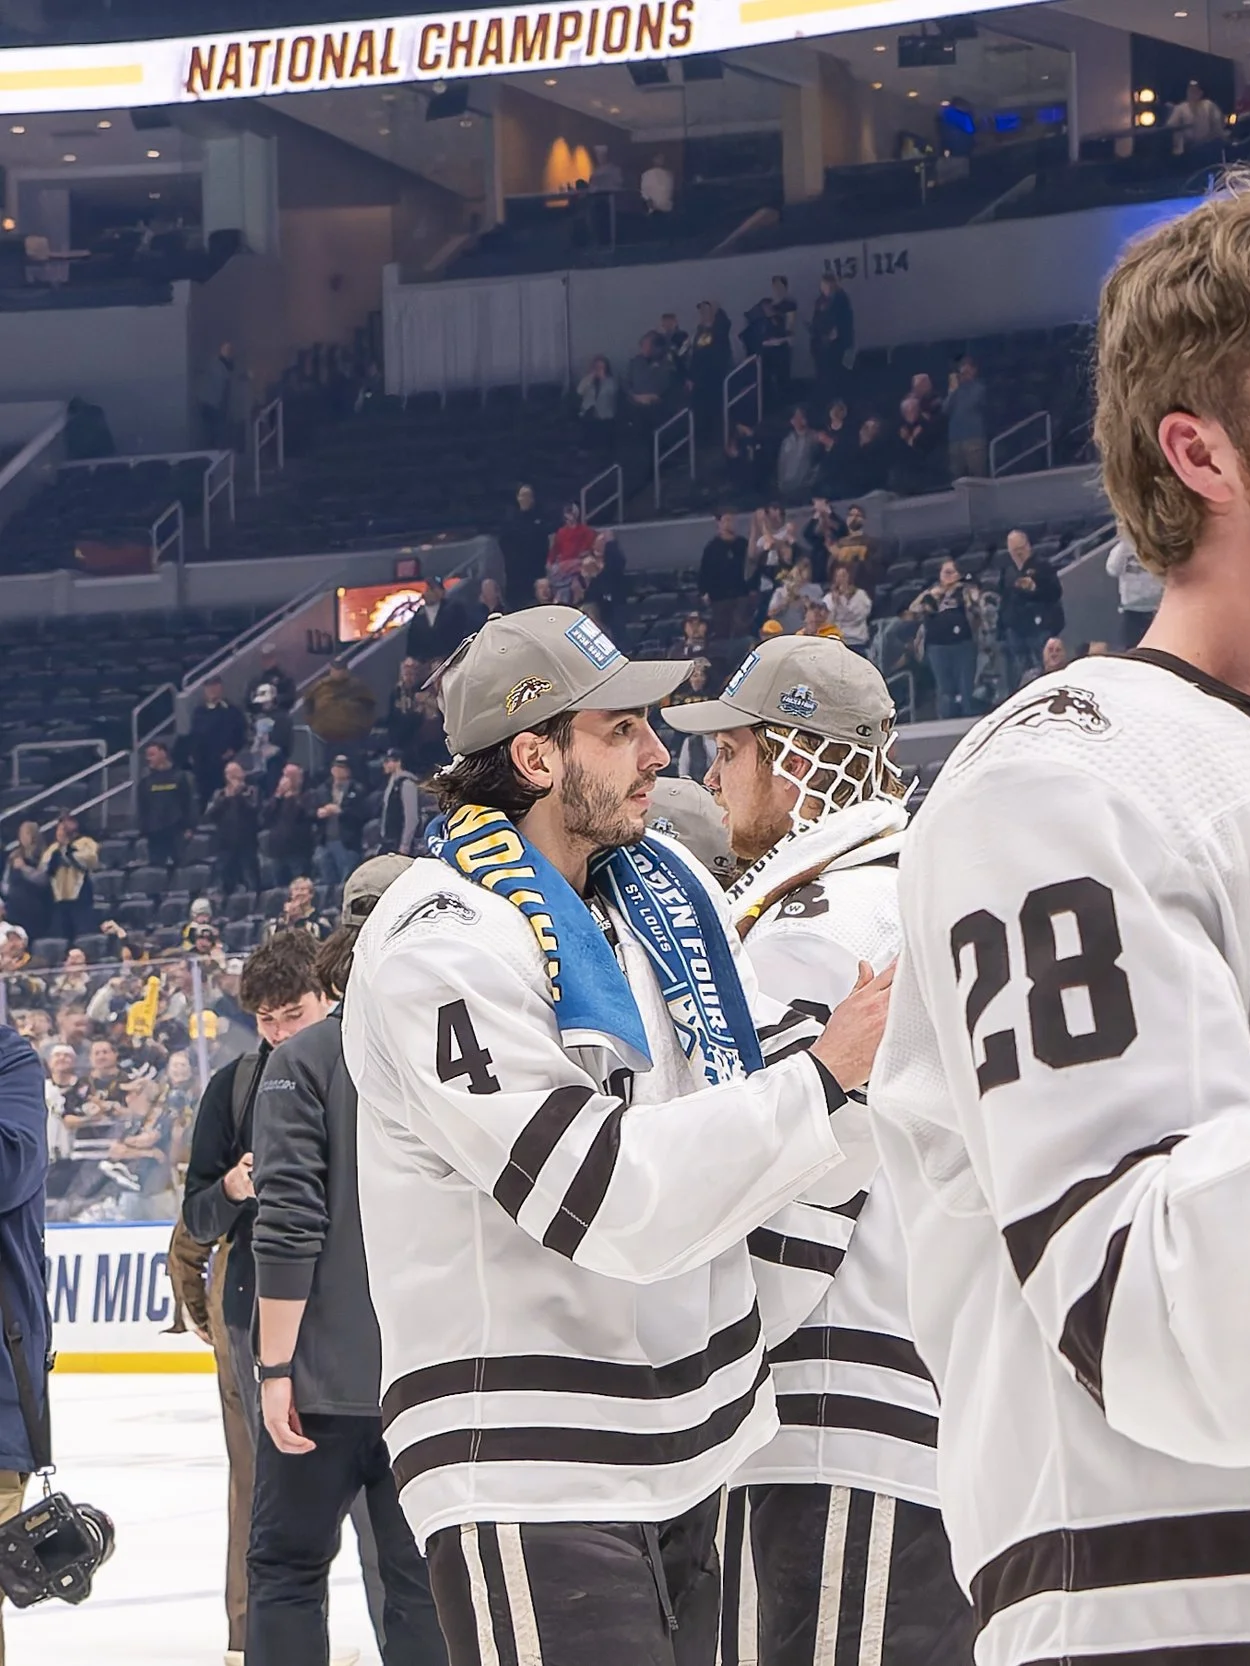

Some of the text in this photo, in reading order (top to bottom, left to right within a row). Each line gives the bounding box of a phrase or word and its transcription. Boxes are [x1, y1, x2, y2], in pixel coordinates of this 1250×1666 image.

[186, 0, 695, 94] NATIONAL CHAMPIONS
[873, 249, 909, 275] 114
[623, 883, 673, 954] ST. LOUIS
[679, 936, 730, 1036] FOUR
[950, 876, 1139, 1101] 28
[436, 998, 502, 1095] 4
